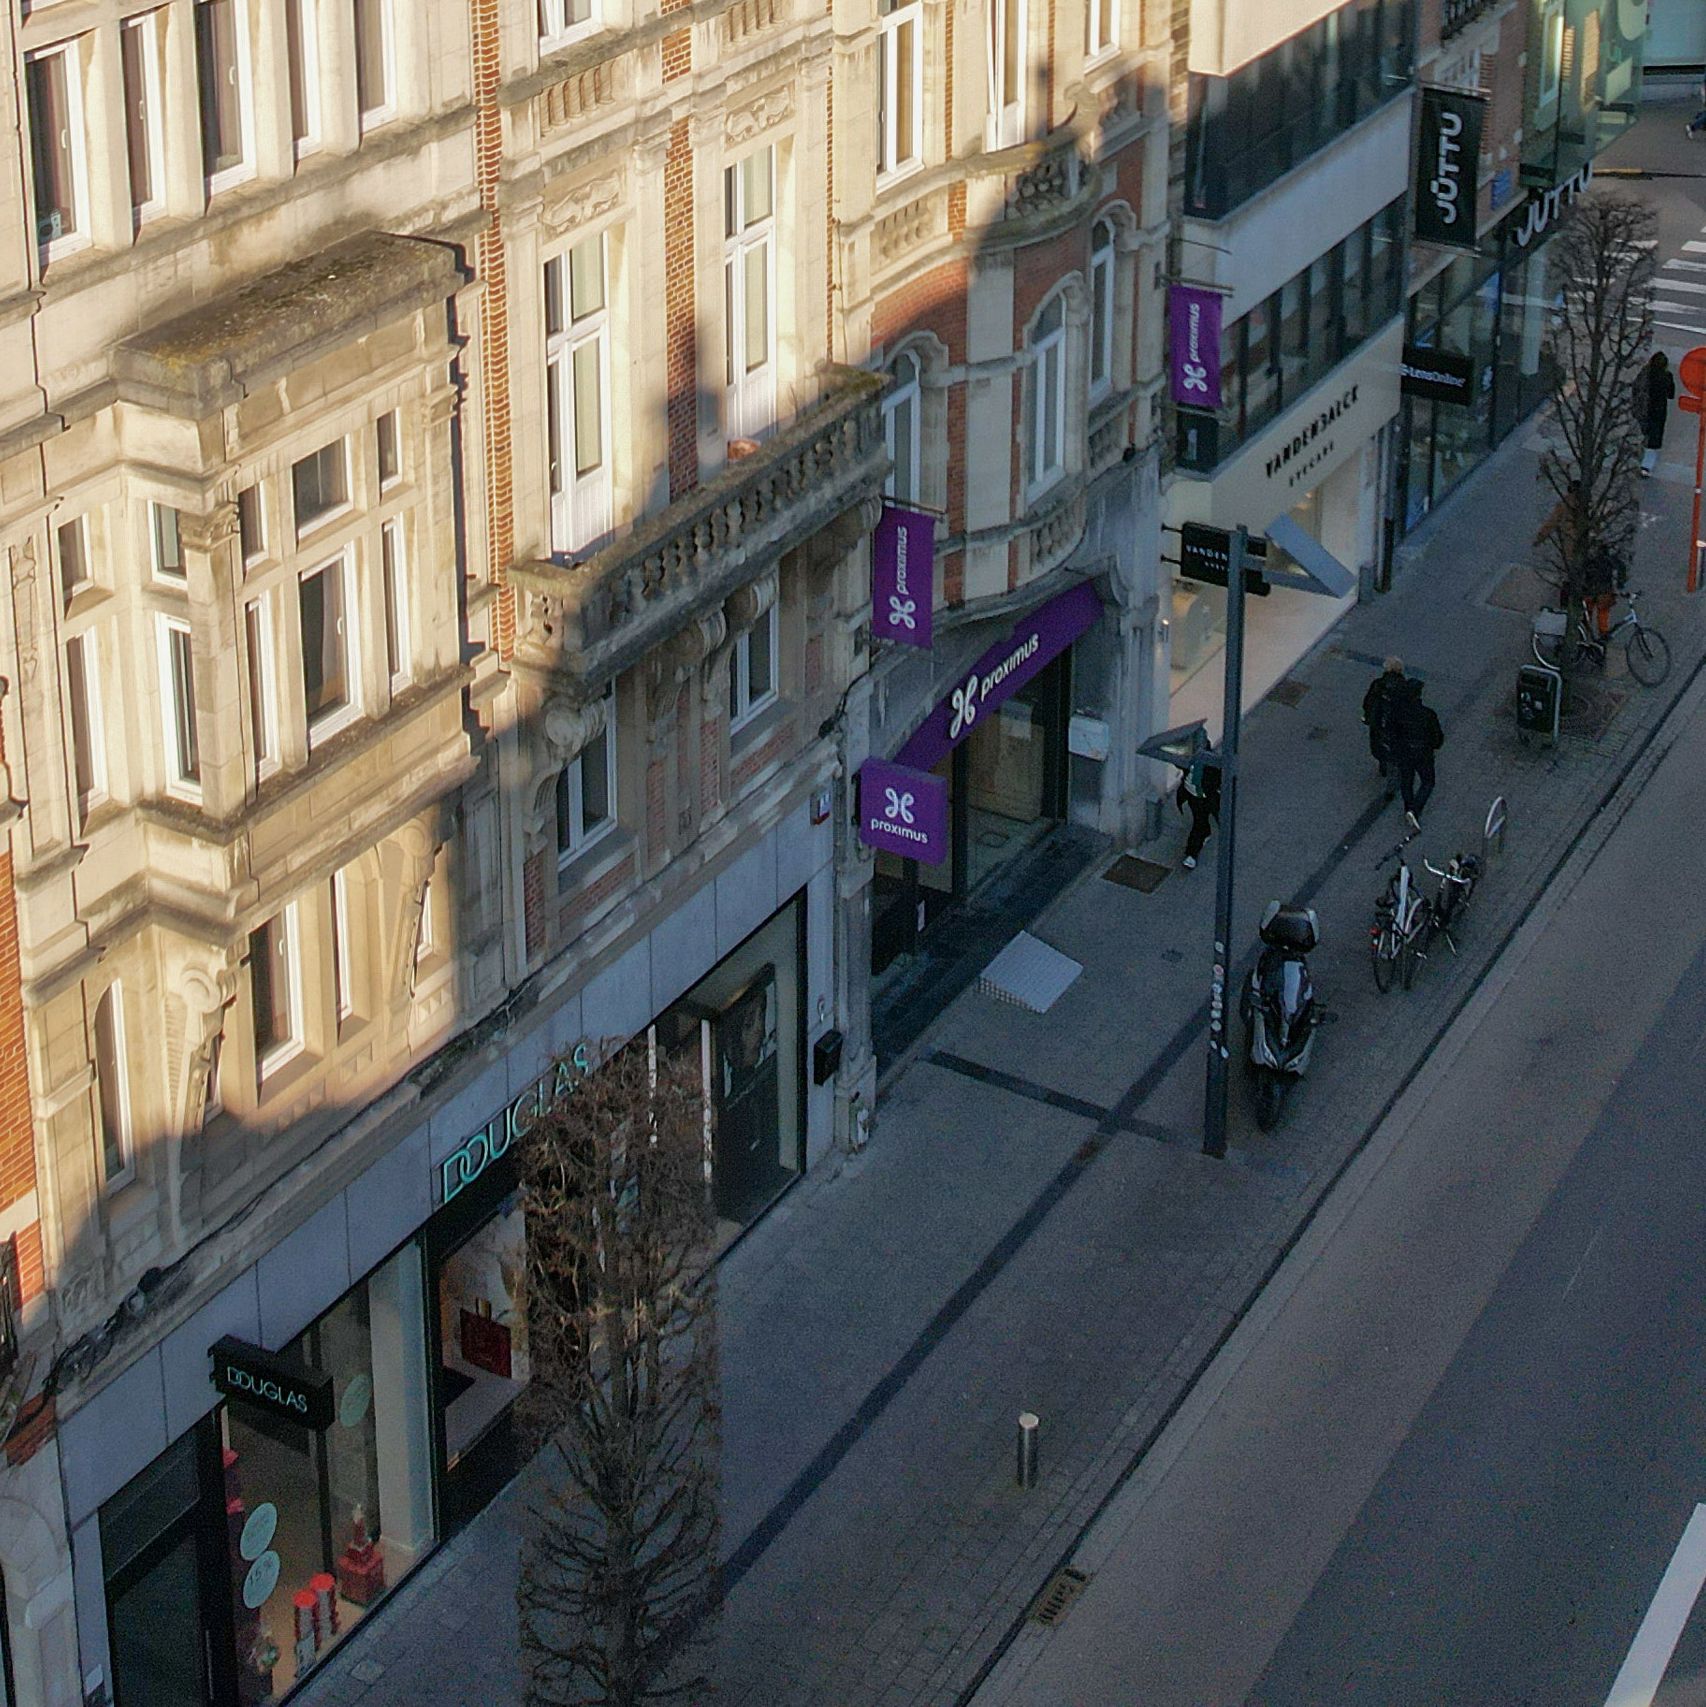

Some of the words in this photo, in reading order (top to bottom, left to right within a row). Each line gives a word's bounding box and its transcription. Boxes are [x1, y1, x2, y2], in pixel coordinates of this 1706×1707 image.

[1189, 302, 1201, 363] proximus
[895, 525, 908, 595] proximus
[980, 633, 1040, 702] proximus
[871, 817, 928, 844] proximus
[227, 1366, 308, 1413] DOUGLAS
